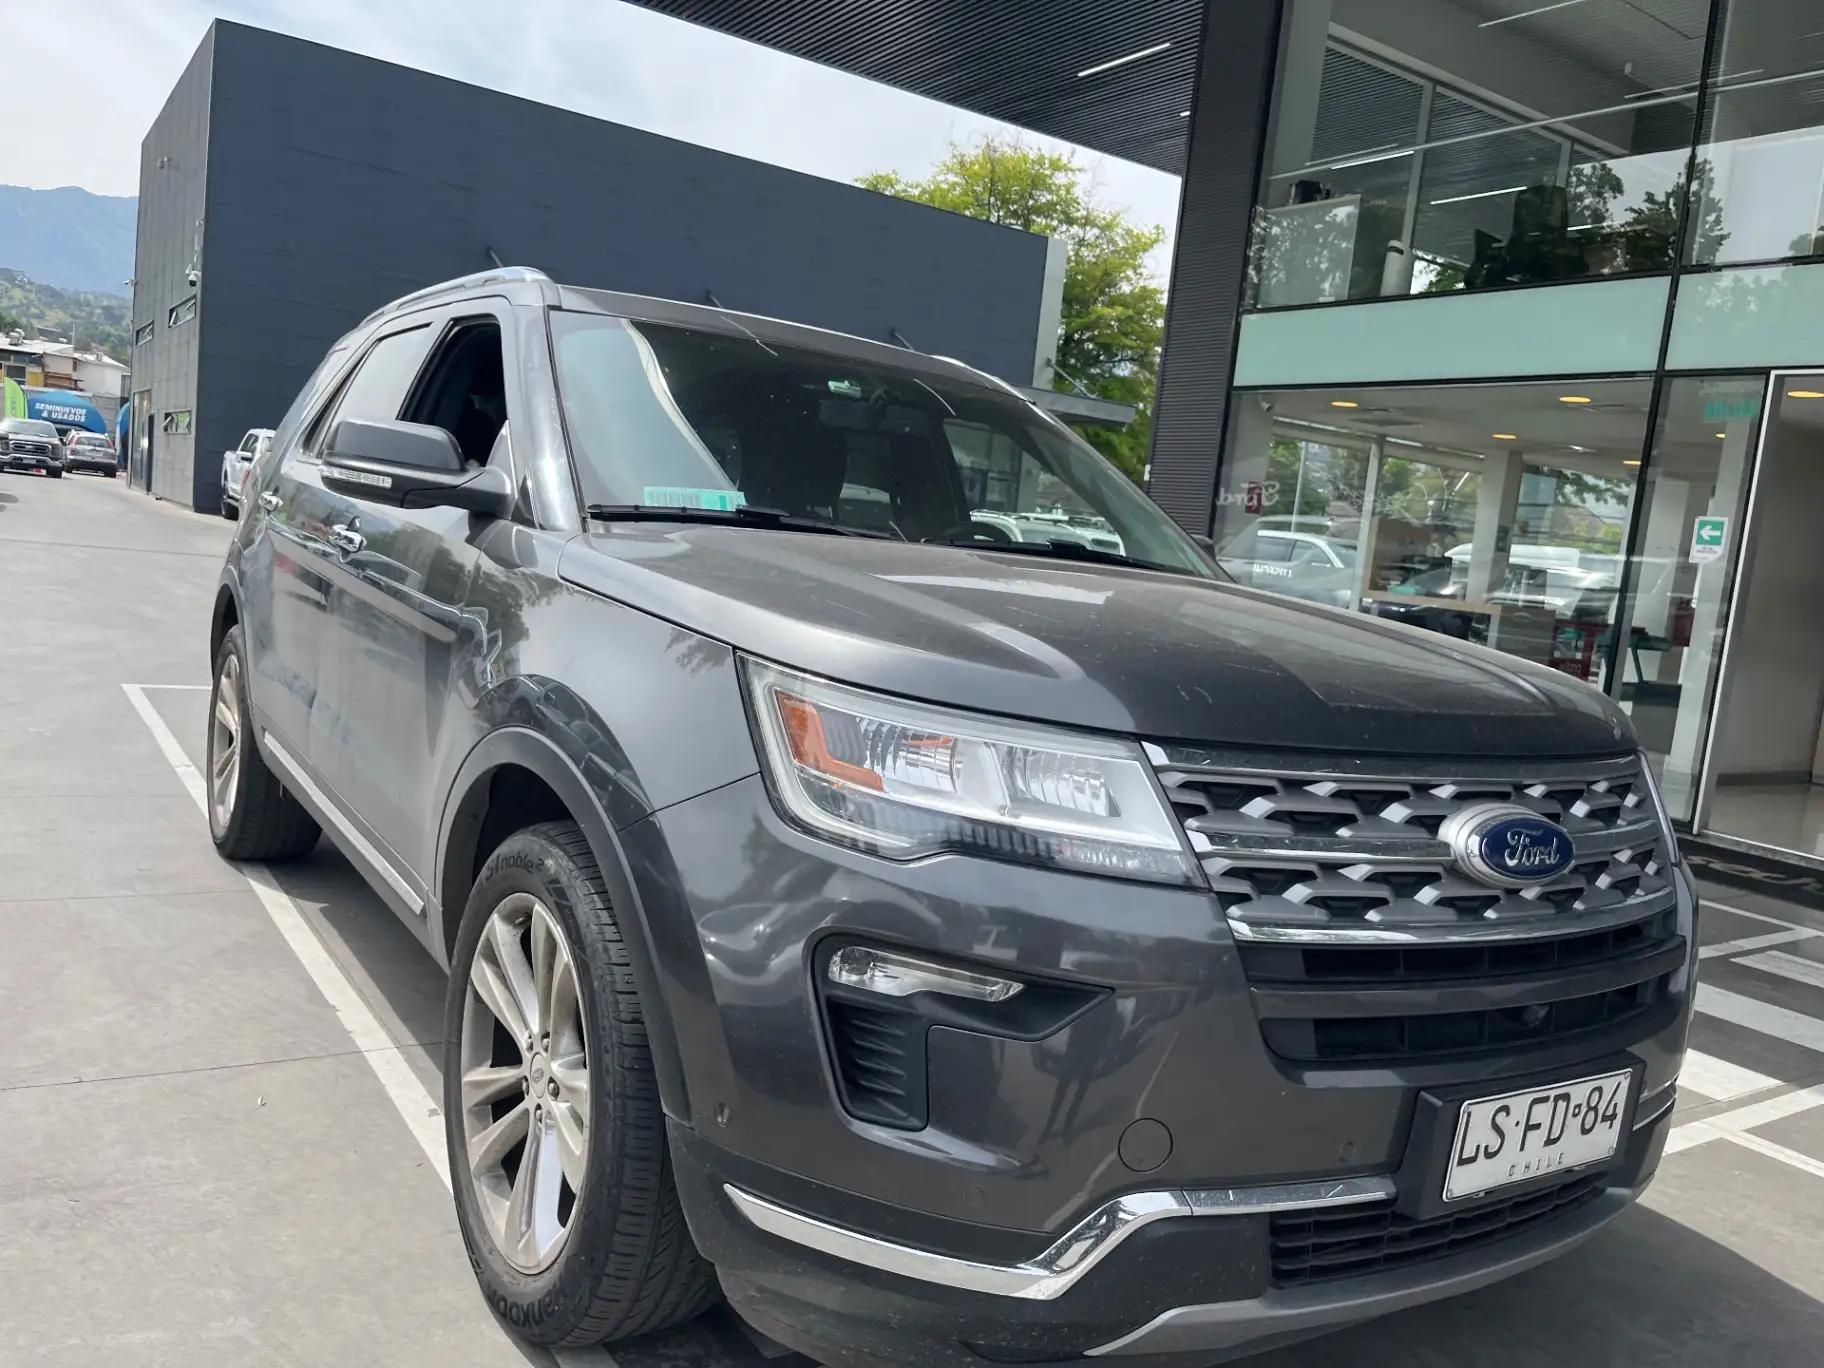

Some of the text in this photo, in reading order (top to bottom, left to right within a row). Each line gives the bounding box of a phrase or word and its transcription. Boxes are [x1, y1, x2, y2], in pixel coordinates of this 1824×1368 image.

[34, 402, 88, 415] SEMINUEVOS
[41, 410, 86, 422] & USADOS
[1504, 828, 1560, 867] Ford
[1508, 1152, 1565, 1177] CHILE
